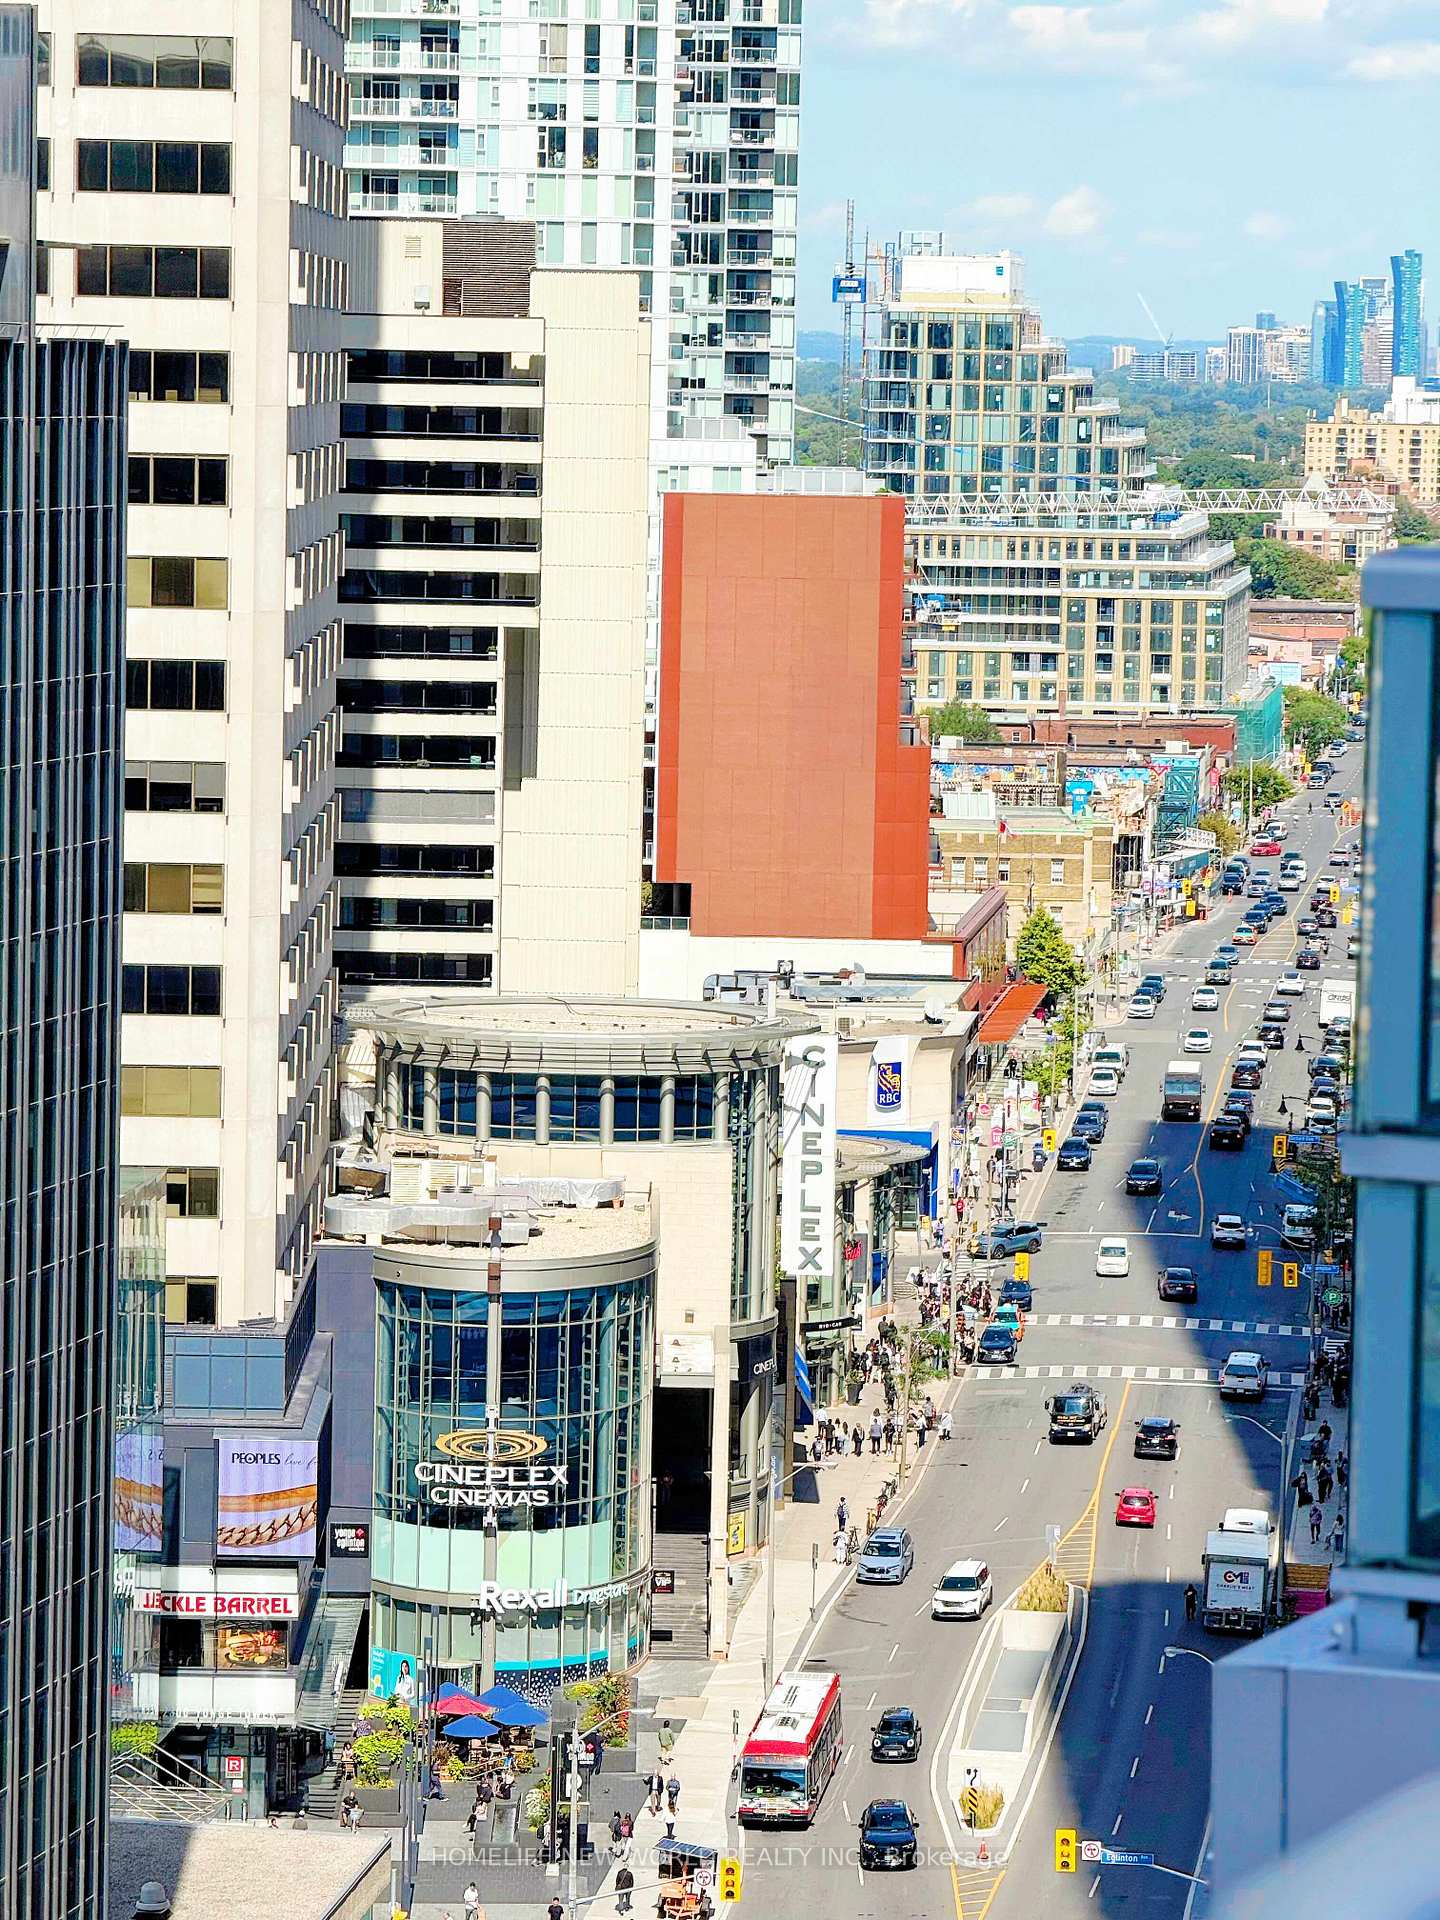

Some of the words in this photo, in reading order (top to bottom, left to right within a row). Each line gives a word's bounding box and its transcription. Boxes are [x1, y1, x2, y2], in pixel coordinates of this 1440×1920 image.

[879, 1093, 900, 1103] RBC
[798, 1045, 825, 1271] CINEPLEX
[231, 1452, 280, 1465] PEOPLES
[414, 1461, 569, 1486] CINEPLEX
[430, 1486, 550, 1507] CINEMAS
[655, 1579, 672, 1587] VIP
[479, 1578, 568, 1613] Rexall
[572, 1582, 630, 1606] Drugstore
[213, 1597, 293, 1615] BARREL
[229, 1760, 240, 1771] R
